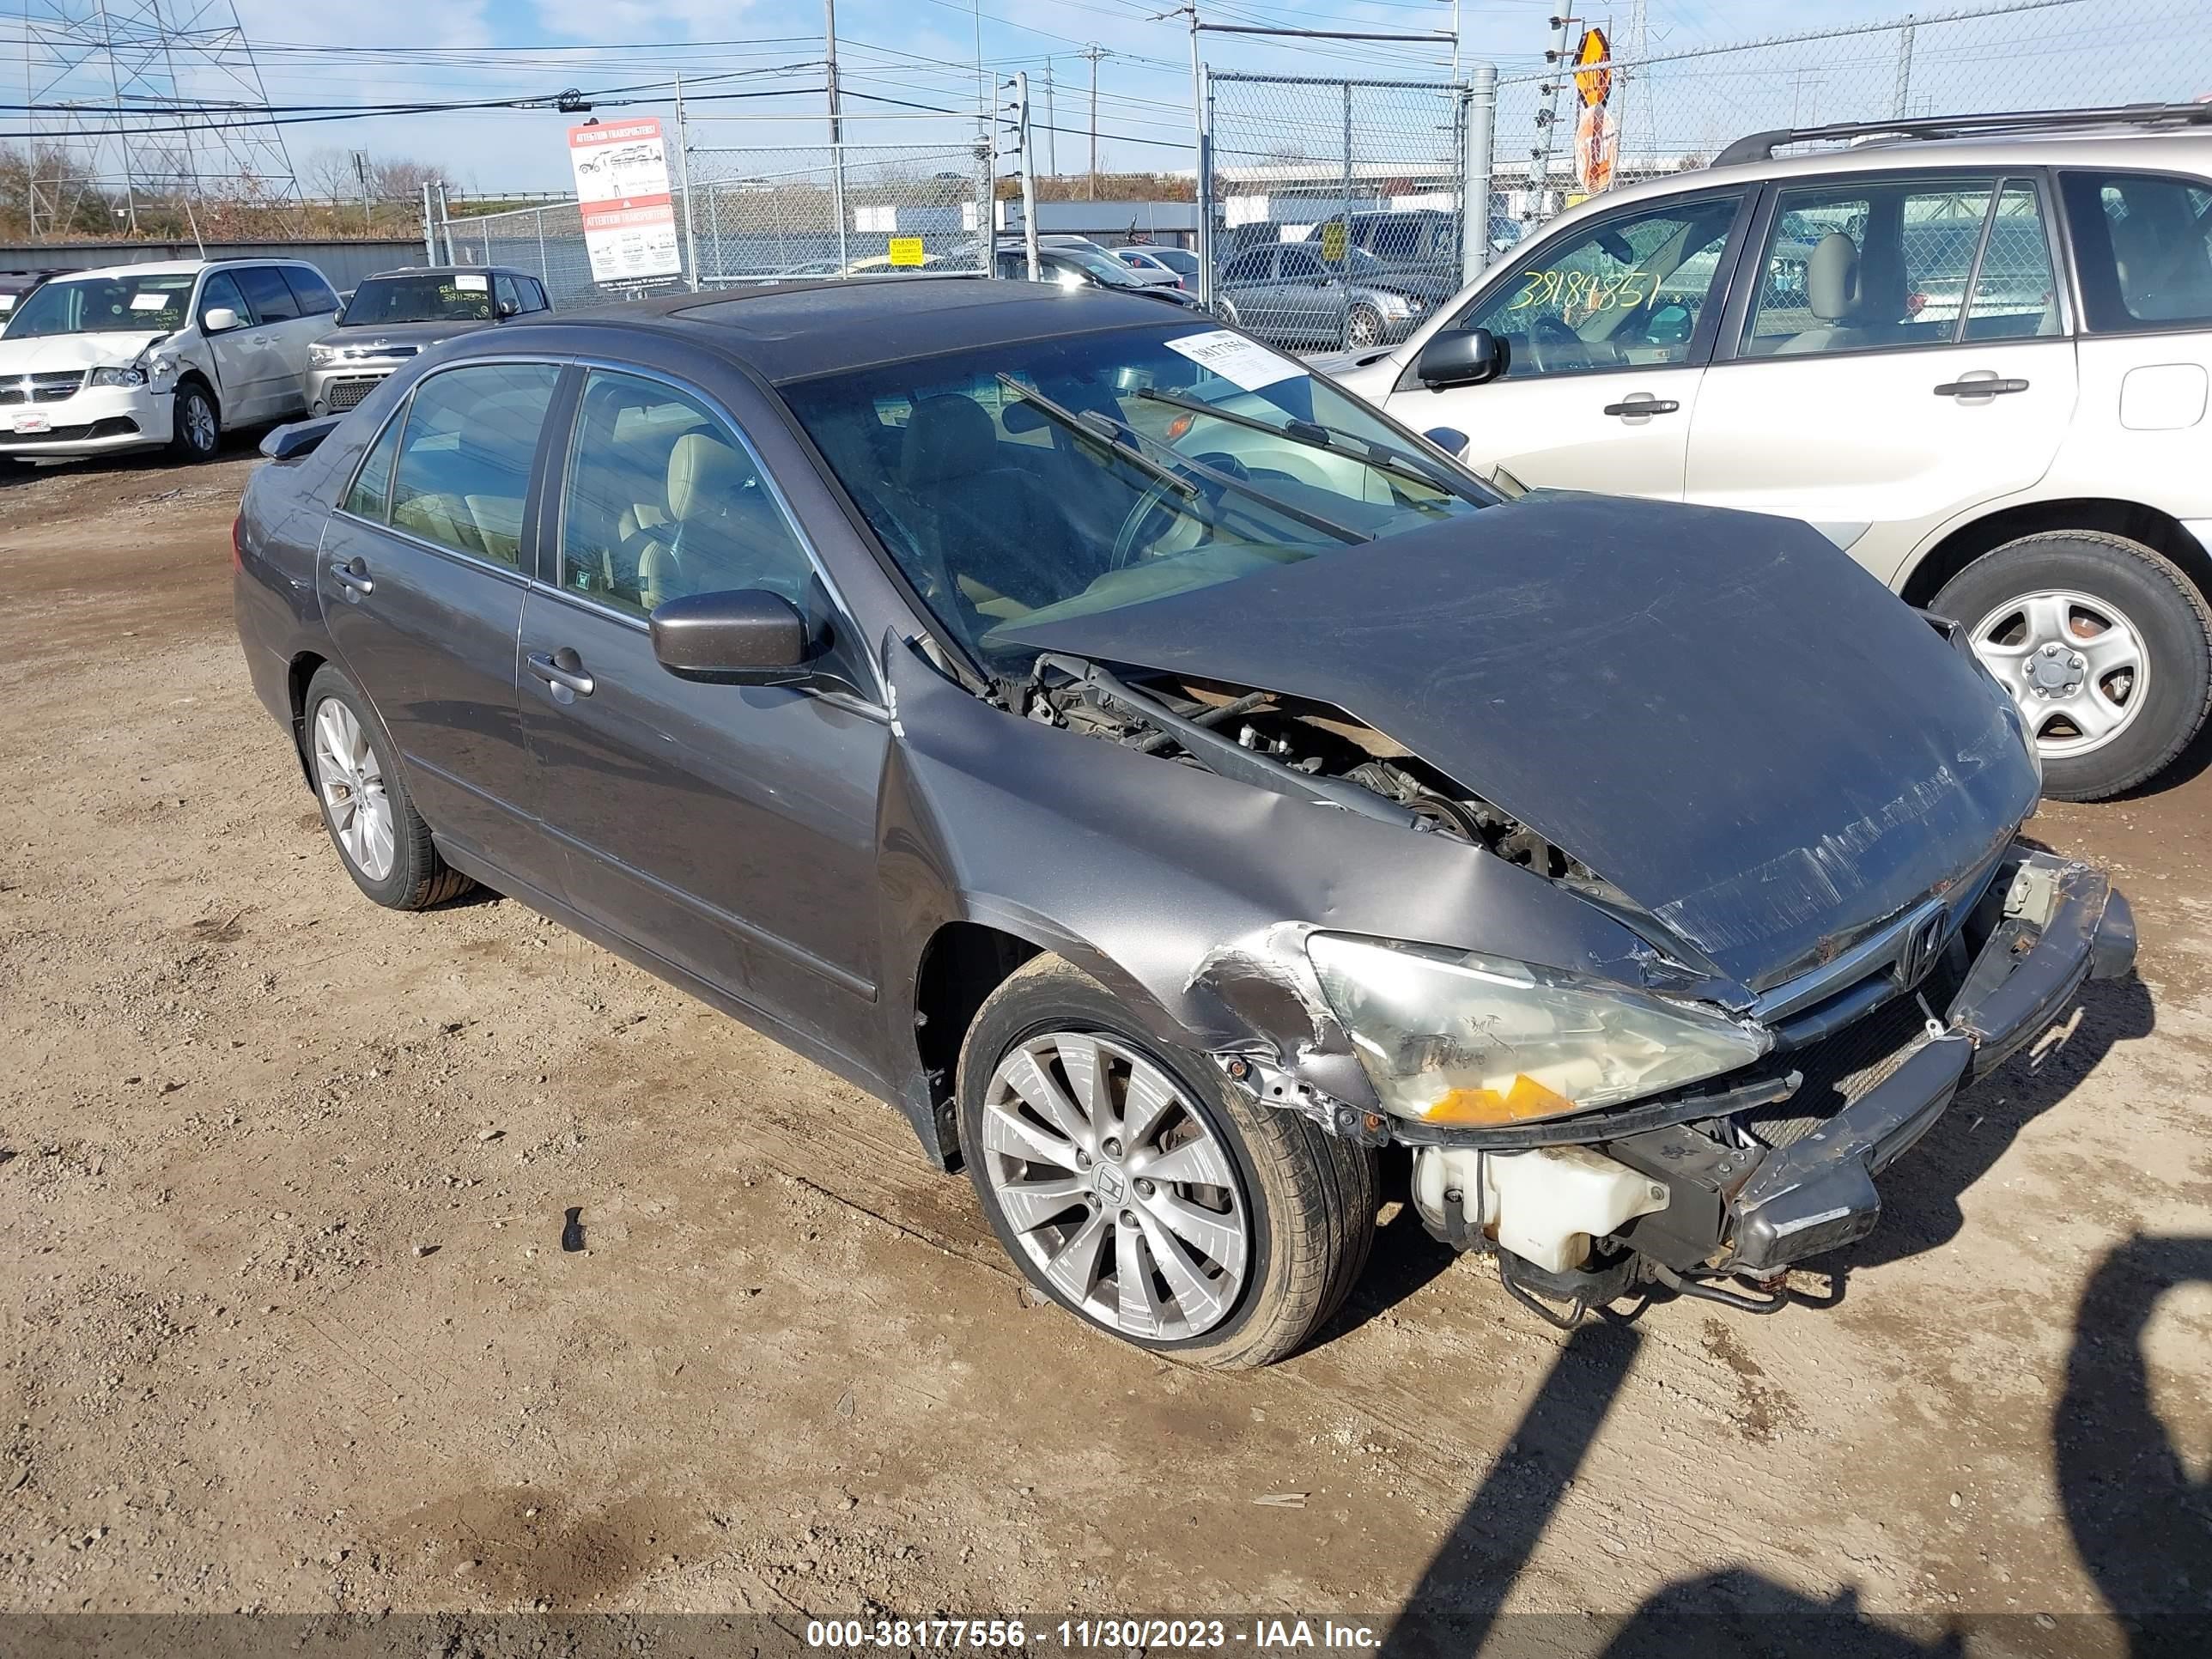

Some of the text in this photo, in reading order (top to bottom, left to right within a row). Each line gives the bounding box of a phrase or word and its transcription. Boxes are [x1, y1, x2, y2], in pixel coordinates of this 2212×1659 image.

[576, 131, 608, 143] ATTENTION
[586, 215, 620, 228] ATTENTION
[1508, 271, 1662, 311] 38184851
[1192, 339, 1252, 361] 38177556
